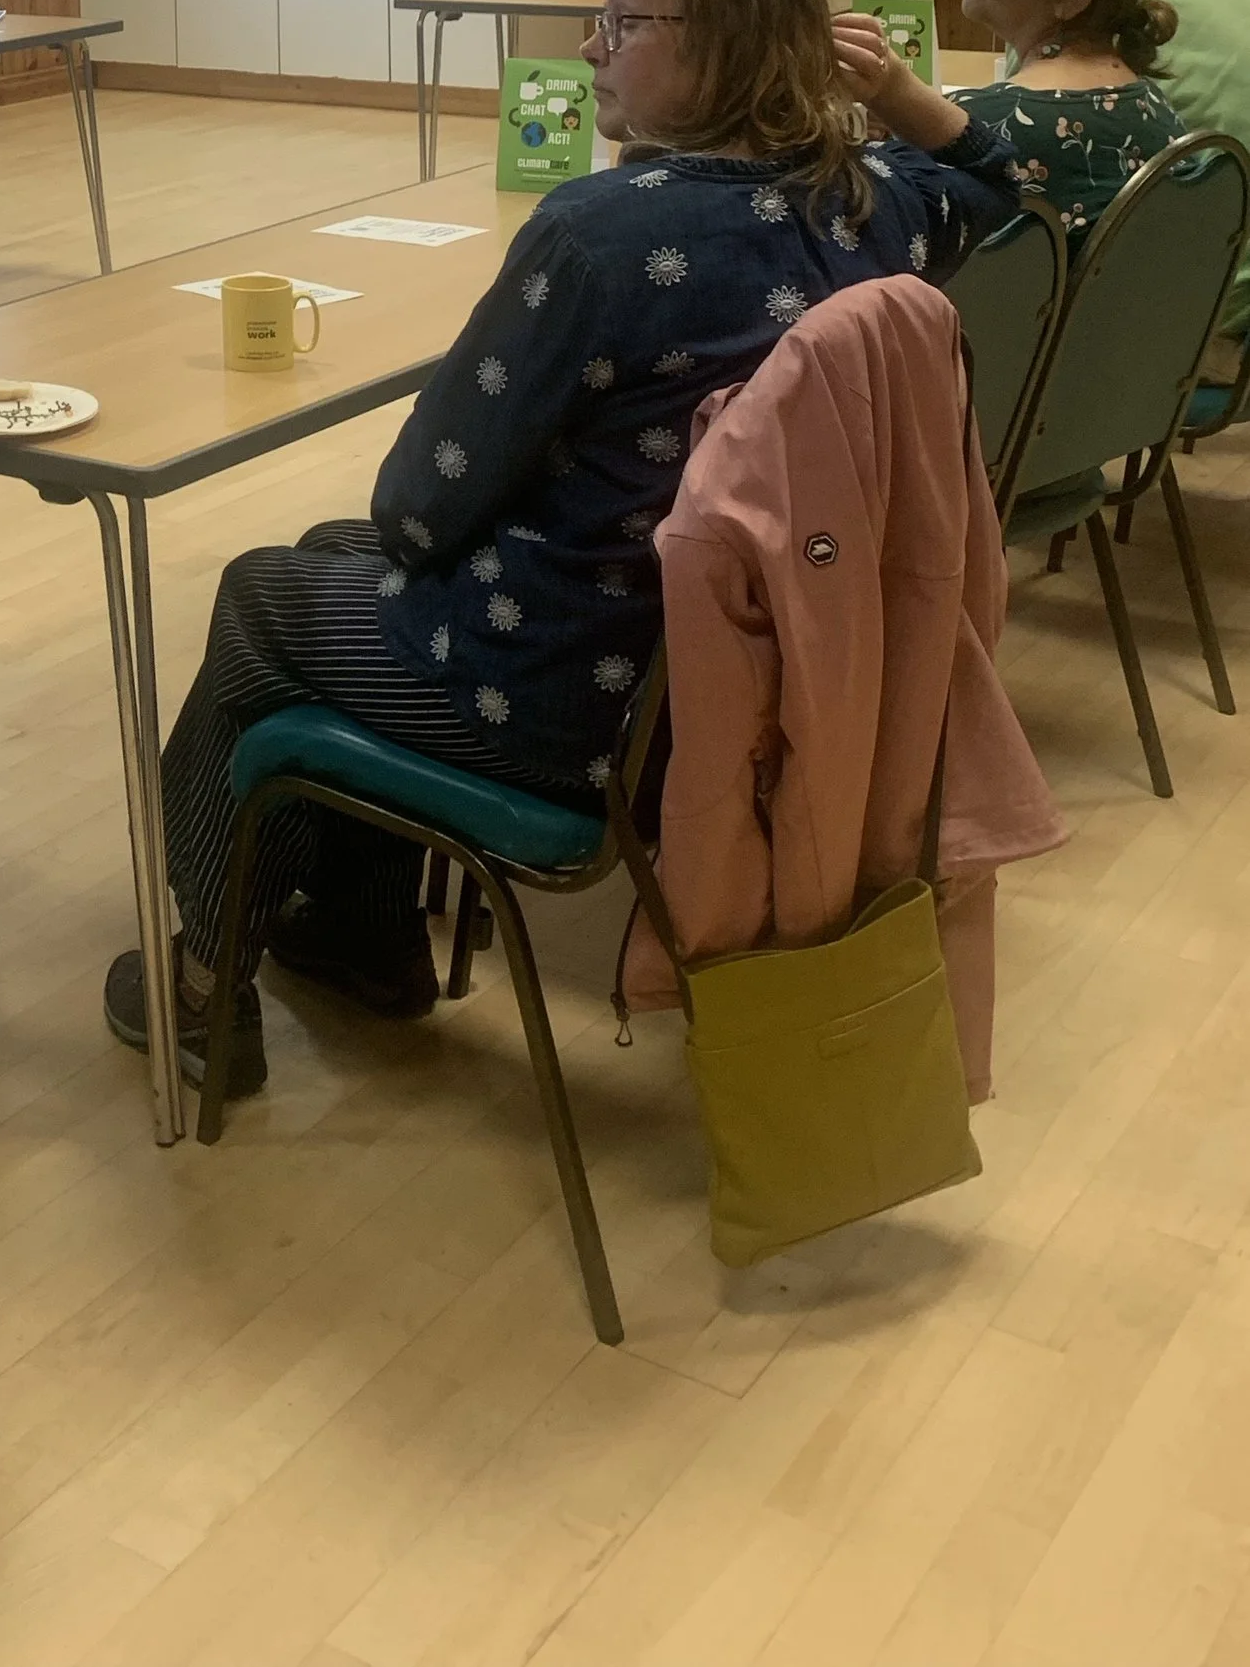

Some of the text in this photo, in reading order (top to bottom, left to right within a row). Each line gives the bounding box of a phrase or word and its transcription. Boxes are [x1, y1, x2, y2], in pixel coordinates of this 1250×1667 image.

[889, 13, 916, 25] DRINK
[545, 78, 578, 92] DRINK
[520, 103, 546, 116] CHAT
[547, 132, 571, 146] ACT!
[247, 329, 277, 340] work
